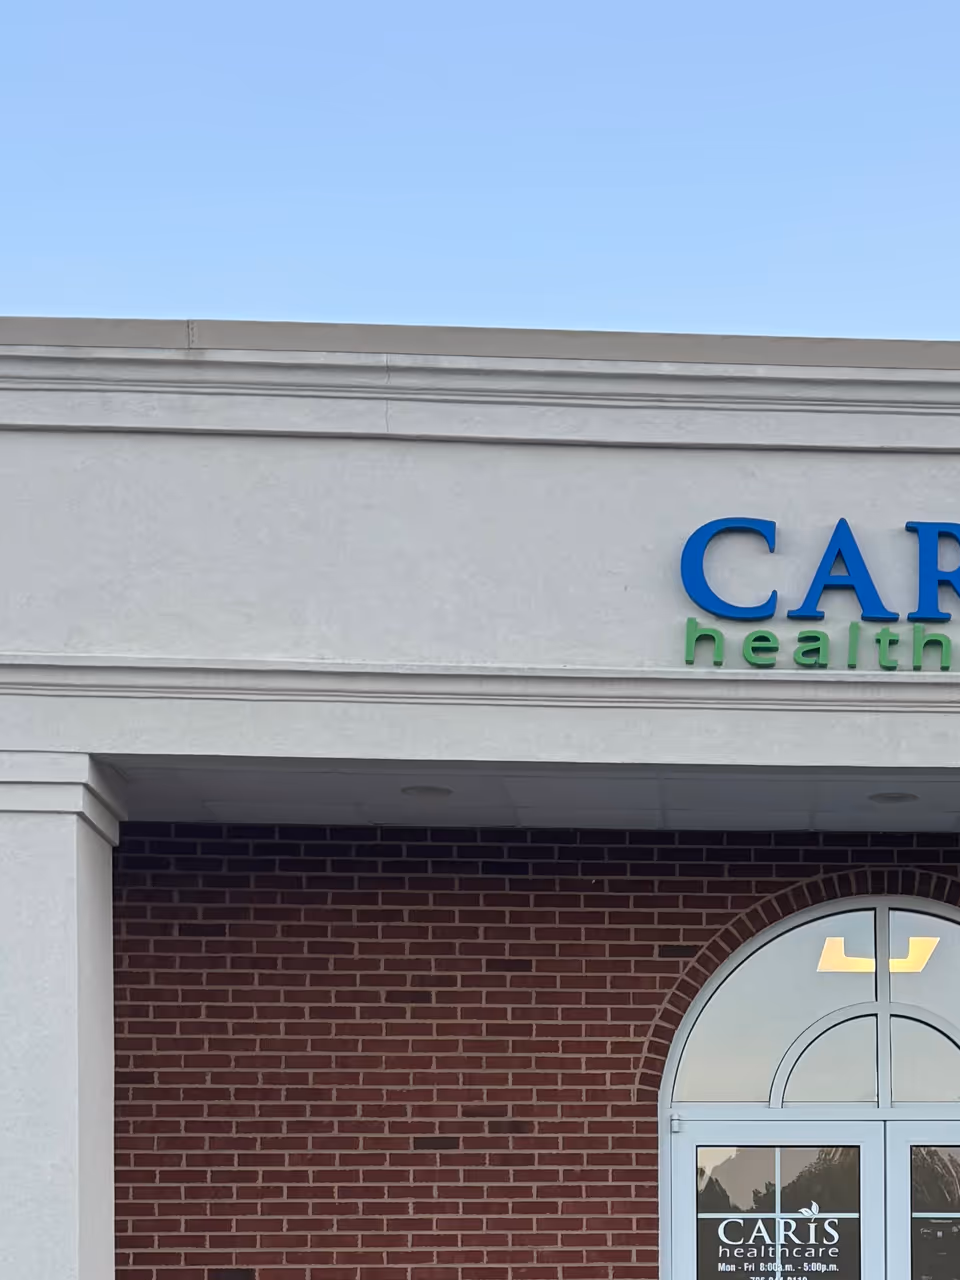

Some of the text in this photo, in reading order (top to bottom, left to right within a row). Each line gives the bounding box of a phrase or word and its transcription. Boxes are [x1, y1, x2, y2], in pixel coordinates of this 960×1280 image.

[718, 1245, 840, 1258] healthcare
[717, 1262, 736, 1272] Mon
[744, 1262, 755, 1272] Fri
[803, 1262, 840, 1274] 5:00p.m.
